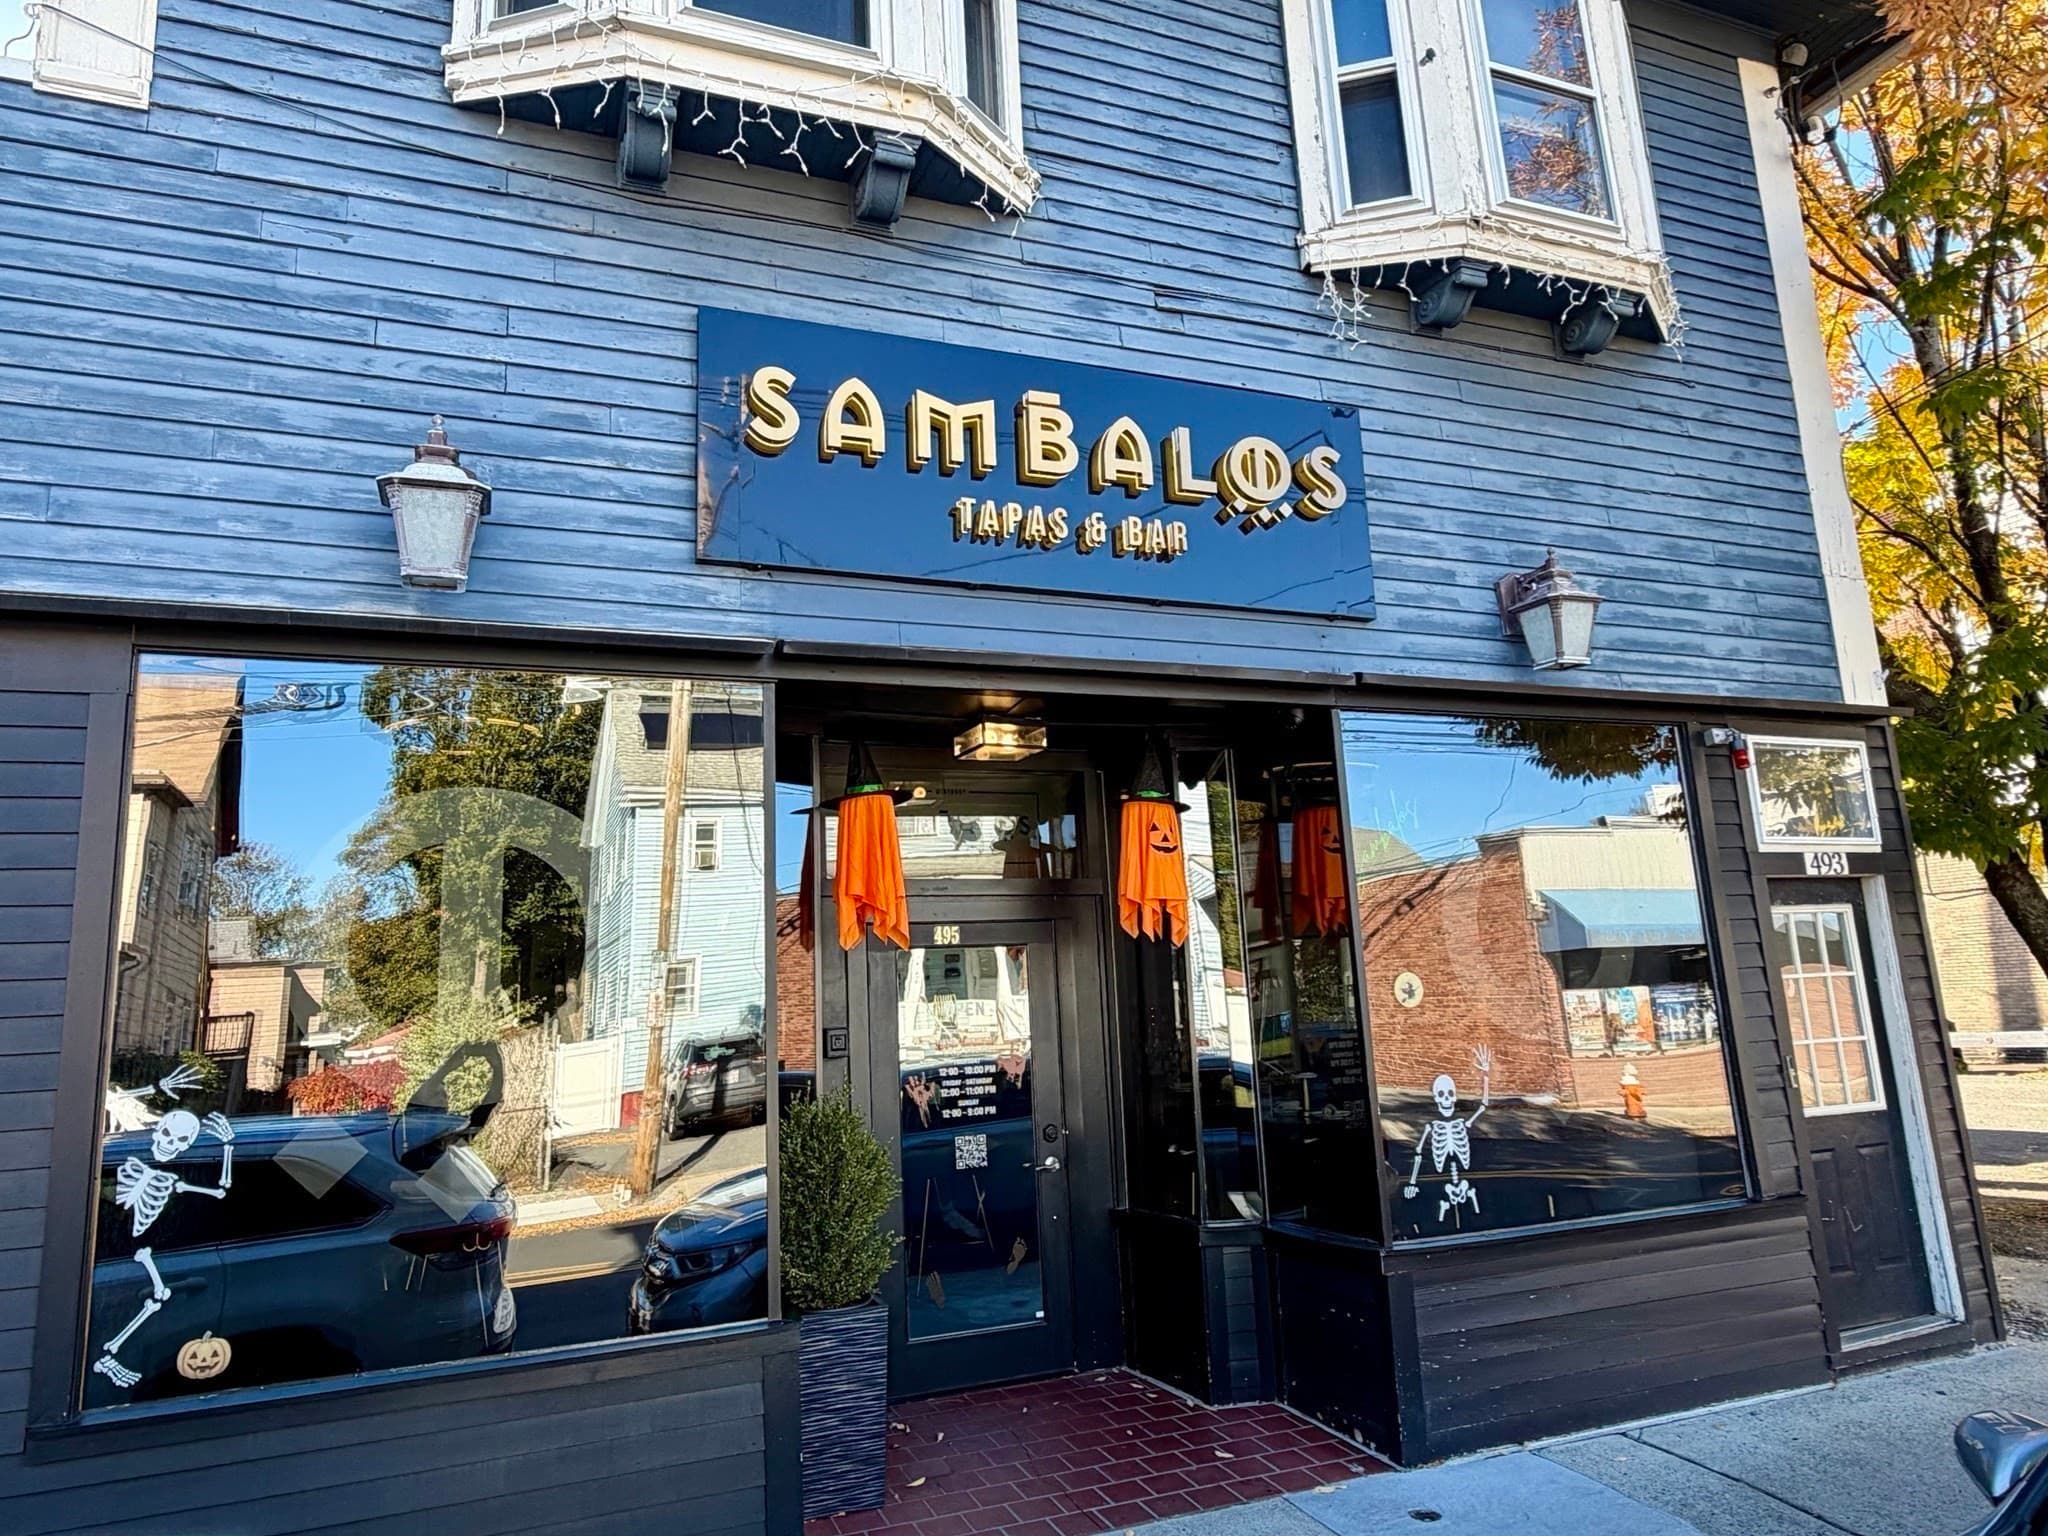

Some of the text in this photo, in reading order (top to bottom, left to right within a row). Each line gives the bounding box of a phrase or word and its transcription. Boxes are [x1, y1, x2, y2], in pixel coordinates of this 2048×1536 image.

[953, 497, 1188, 560] TAPAS & BAR
[1810, 852, 1845, 875] 493
[934, 926, 960, 944] 495
[938, 1067, 959, 1076] 12:00
[984, 1064, 996, 1073] PM
[941, 1087, 960, 1097] 12:00
[984, 1085, 996, 1094] PM
[941, 1108, 962, 1118] 12:00
[984, 1106, 996, 1115] PM
